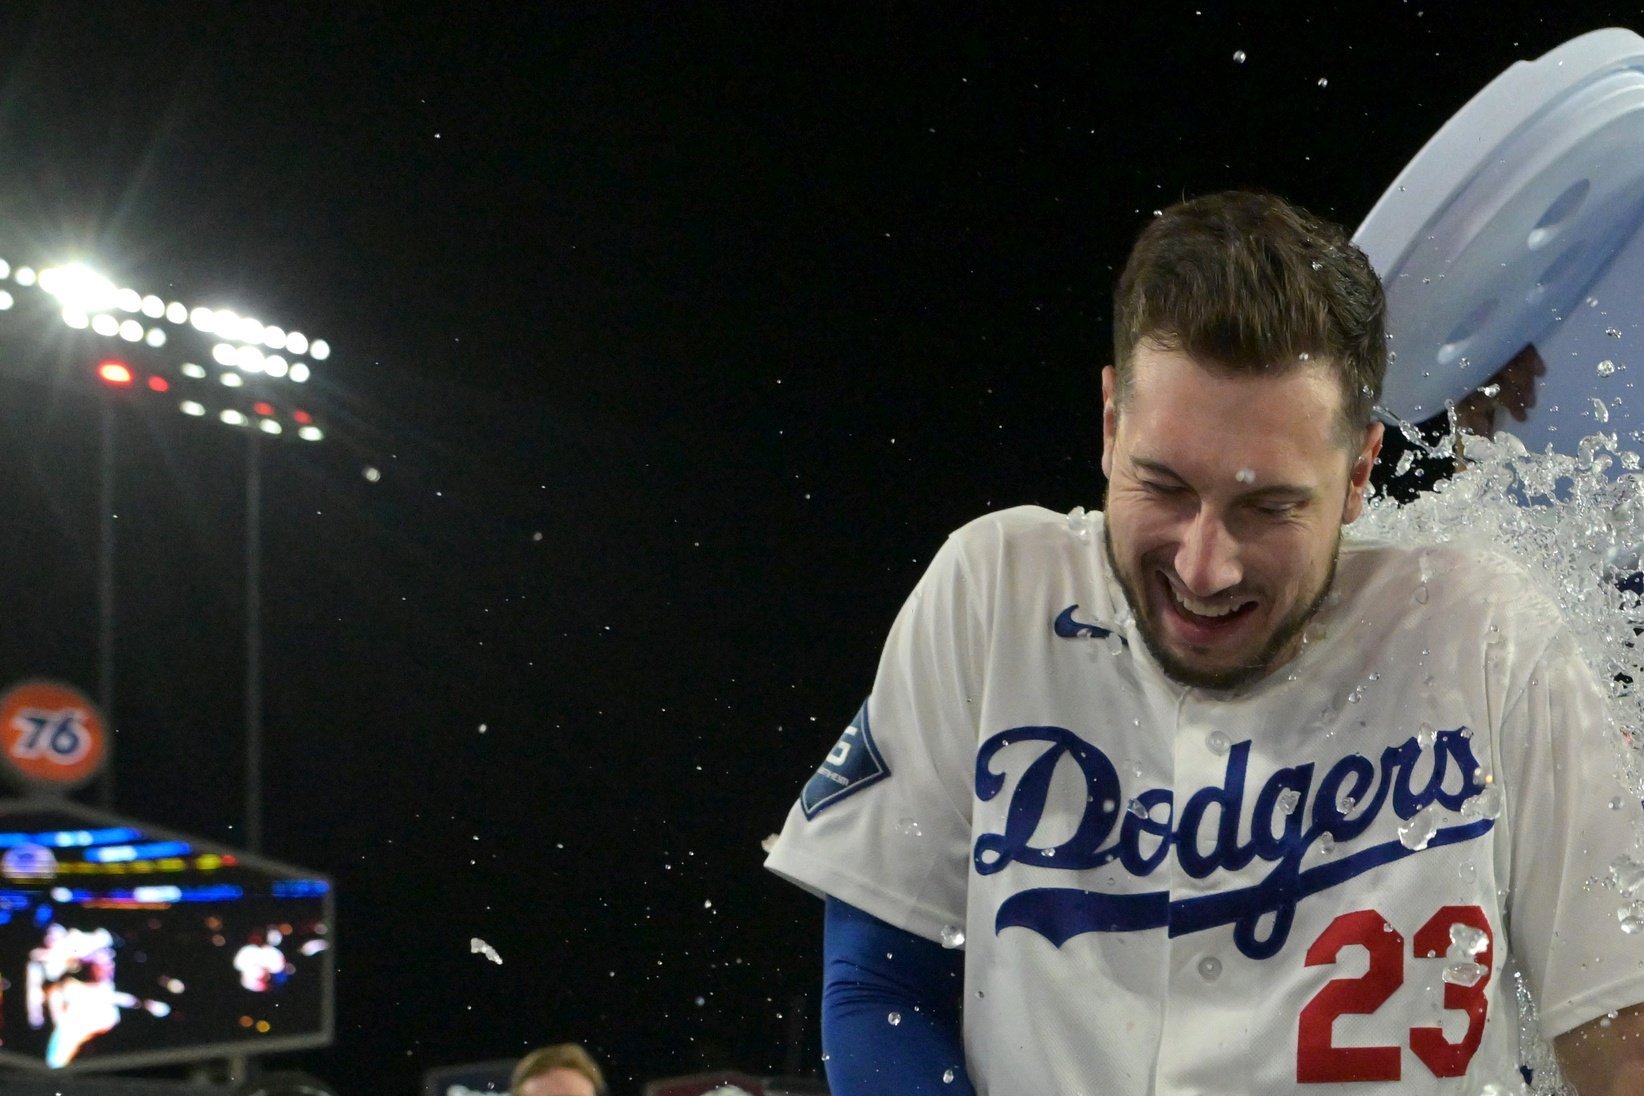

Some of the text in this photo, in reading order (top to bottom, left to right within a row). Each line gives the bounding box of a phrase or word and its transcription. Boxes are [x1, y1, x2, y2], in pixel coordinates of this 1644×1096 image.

[14, 708, 90, 763] 76
[974, 725, 1490, 961] Dodgers
[1297, 905, 1494, 1083] 23
